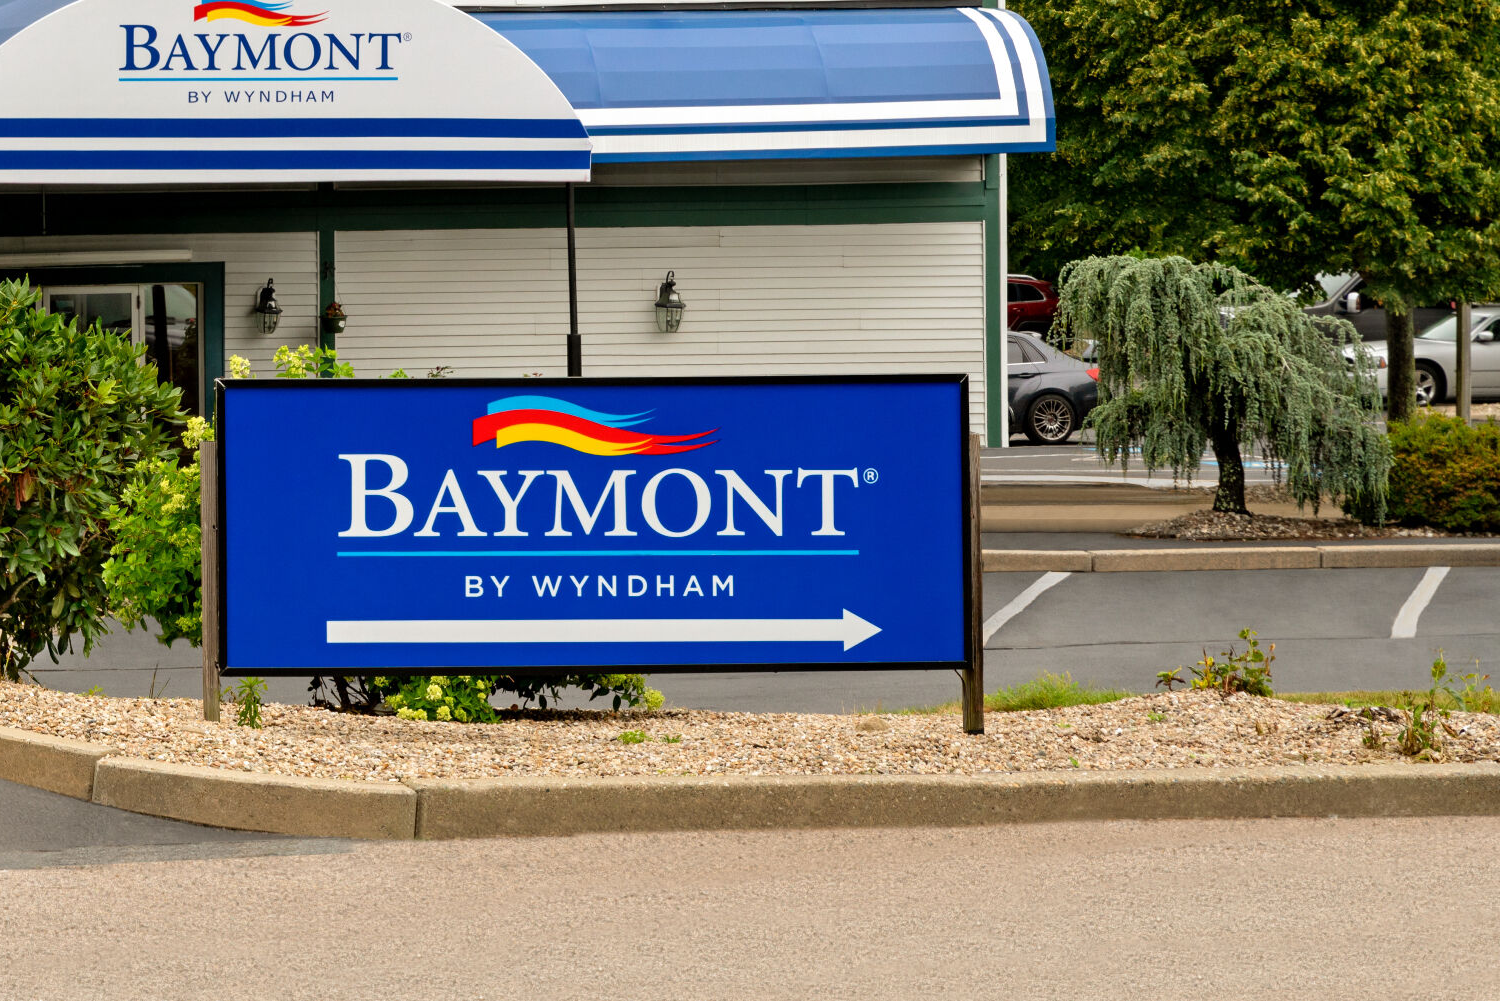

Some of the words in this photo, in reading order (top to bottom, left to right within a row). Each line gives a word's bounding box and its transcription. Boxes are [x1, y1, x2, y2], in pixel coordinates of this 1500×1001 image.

[189, 91, 211, 103] BY
[225, 91, 333, 102] WYNDHAM
[466, 576, 509, 597] BY
[532, 575, 733, 596] WYNDHAM
